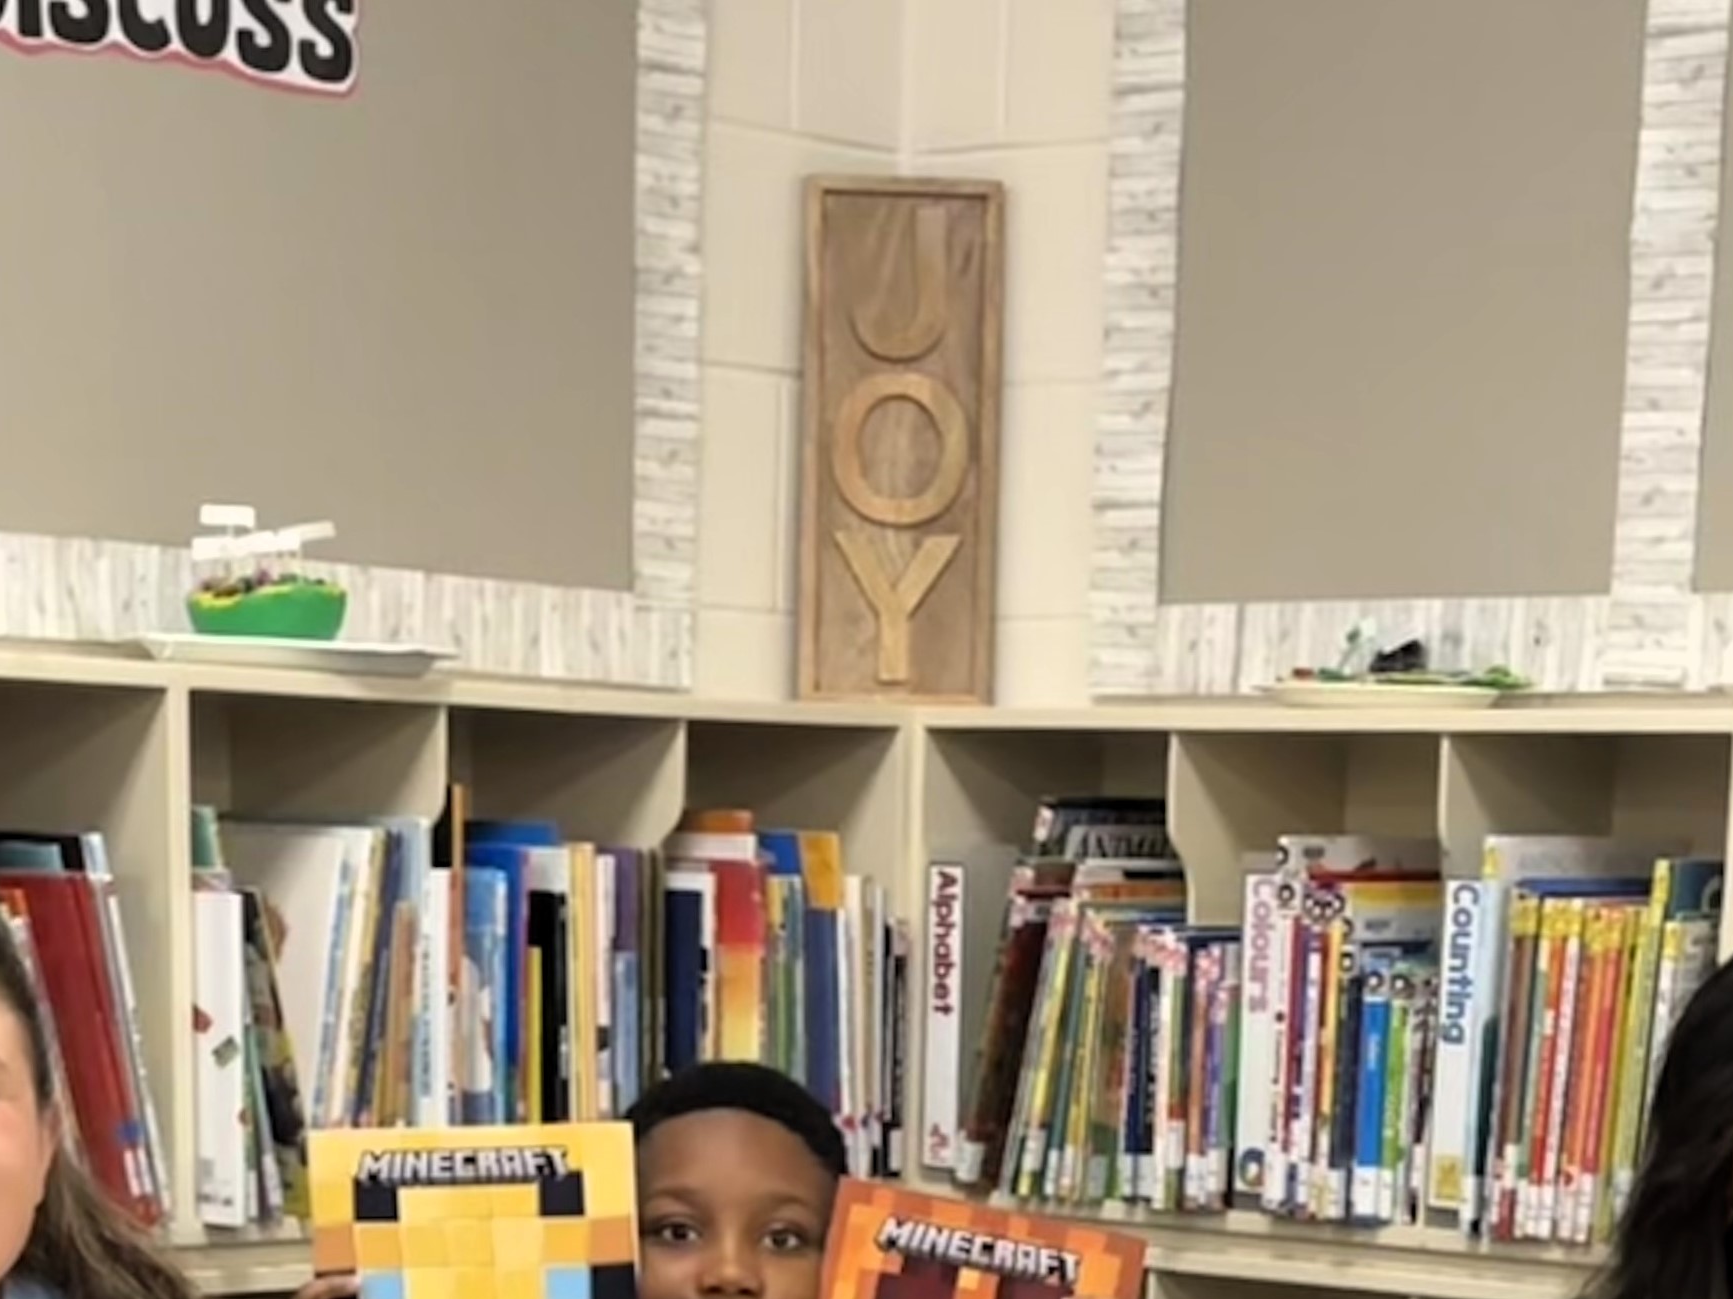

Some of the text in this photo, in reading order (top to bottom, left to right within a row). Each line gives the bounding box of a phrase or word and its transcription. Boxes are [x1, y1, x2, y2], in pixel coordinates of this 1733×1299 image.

[832, 205, 968, 684] JOY
[932, 870, 959, 1015] Alphabet
[1249, 879, 1278, 1014] Colours
[1443, 883, 1480, 1046] Counting
[356, 1145, 570, 1183] MINECRAFT
[875, 1216, 1081, 1284] MINECRAFT
